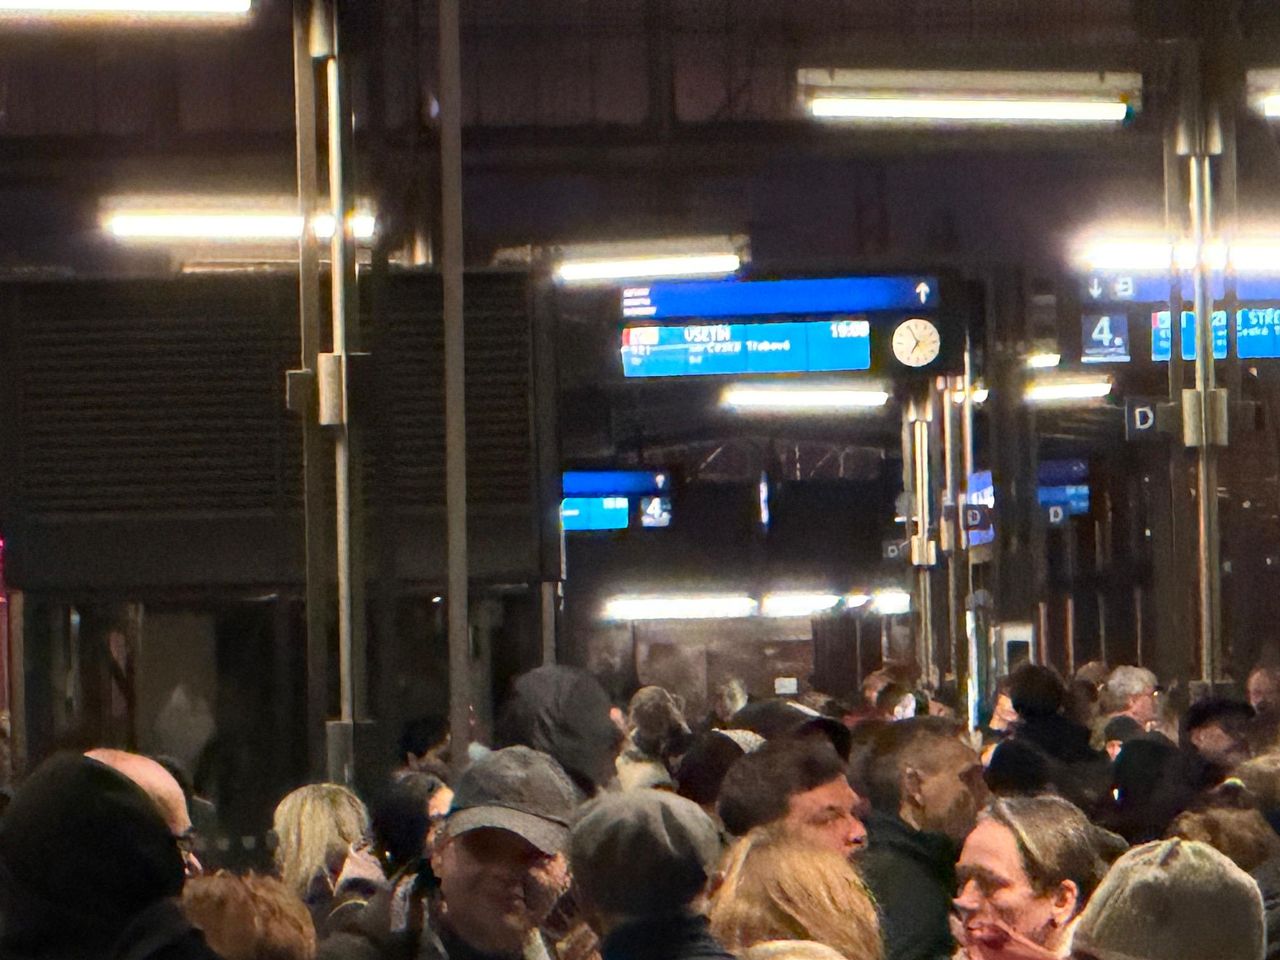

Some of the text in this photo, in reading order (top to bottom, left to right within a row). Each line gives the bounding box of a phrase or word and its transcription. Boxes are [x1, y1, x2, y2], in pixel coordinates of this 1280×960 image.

[1134, 406, 1154, 430] D
[967, 510, 980, 526] D
[1049, 506, 1063, 523] D
